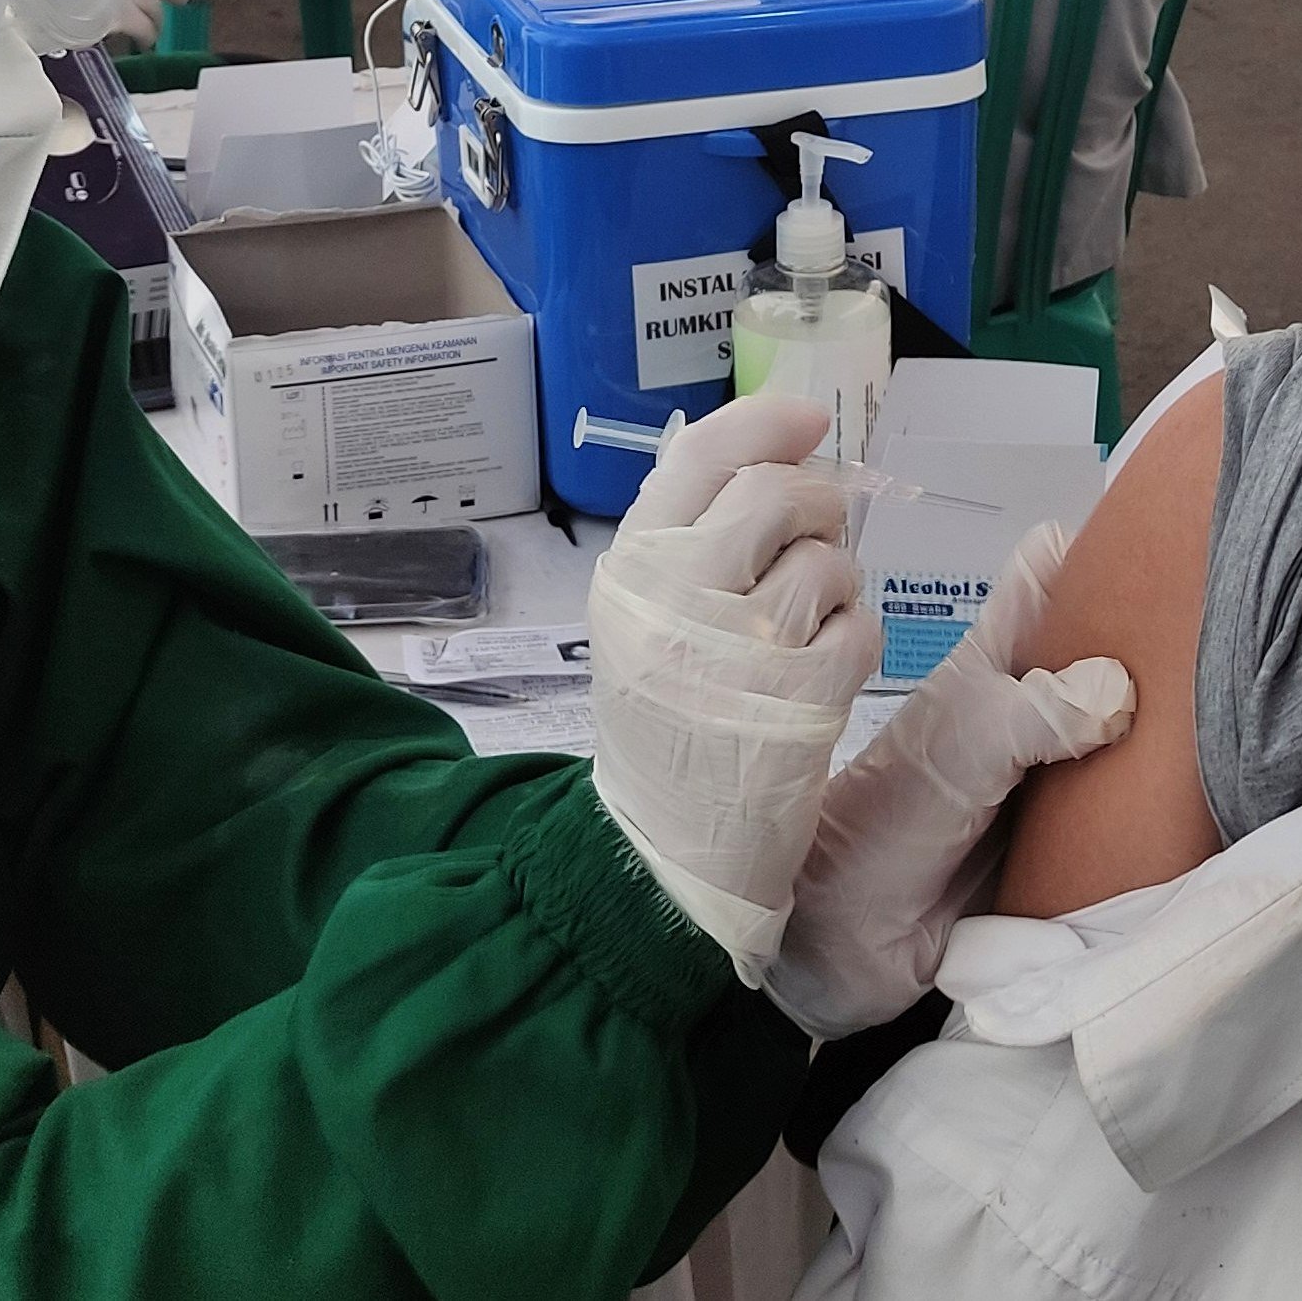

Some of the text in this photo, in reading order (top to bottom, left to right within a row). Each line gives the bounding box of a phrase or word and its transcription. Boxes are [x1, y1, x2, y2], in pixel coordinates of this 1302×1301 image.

[660, 270, 746, 302] INSTAL
[299, 336, 478, 366] INFORMASI PENTING MENGENAI KEAMANAN
[321, 350, 462, 375] IMPORTANT SAFETY INFORMATION
[883, 578, 993, 598] Alcohol S
